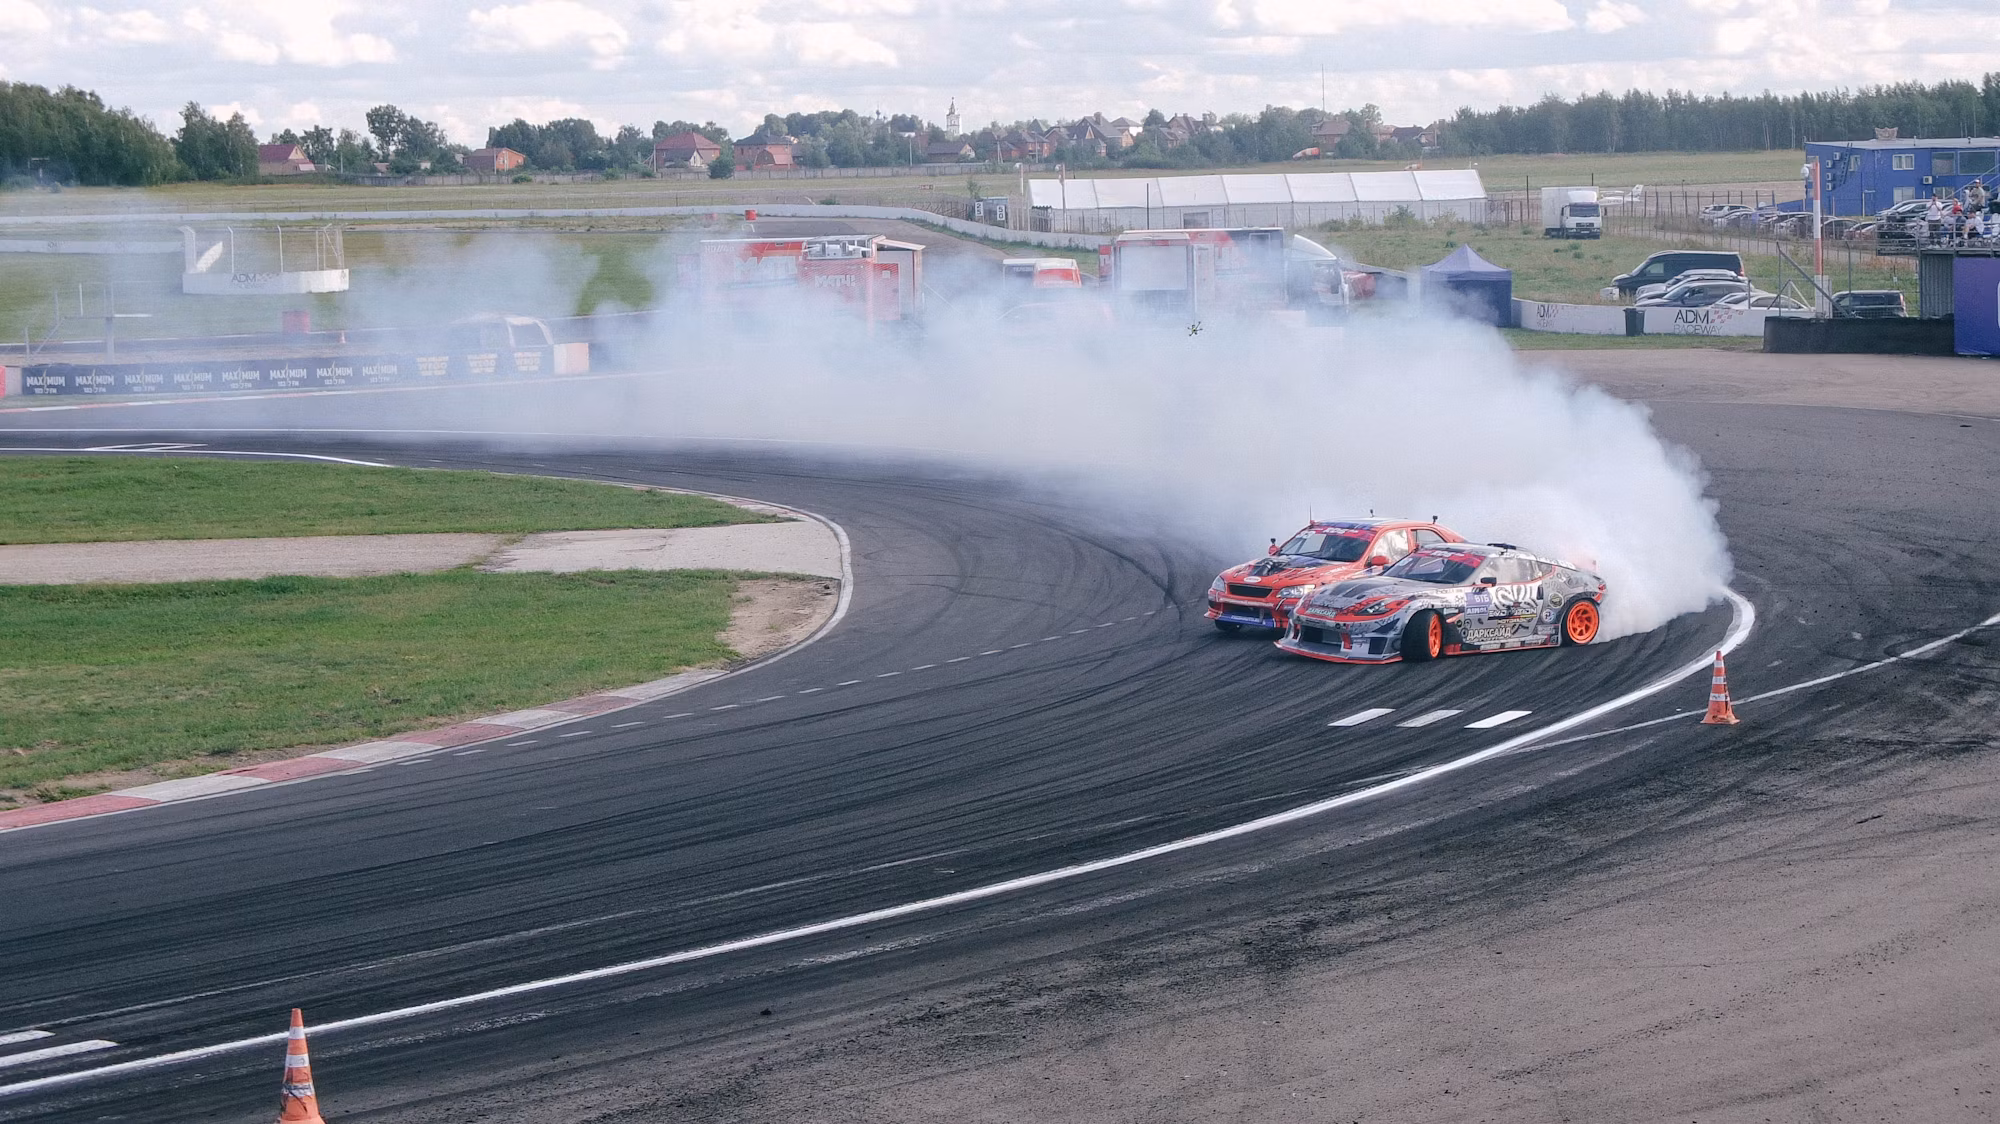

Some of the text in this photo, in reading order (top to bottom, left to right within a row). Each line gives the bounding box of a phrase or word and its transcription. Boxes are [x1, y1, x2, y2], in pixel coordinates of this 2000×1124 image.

[231, 274, 256, 283] ADM
[1674, 309, 1709, 324] ADM
[1673, 325, 1723, 335] RACEWAY
[26, 374, 66, 388] MAXIMUM
[75, 373, 115, 387] MAXIMUM
[1474, 594, 1489, 603] ВТБ
[1466, 626, 1511, 641] ДАРКСАЙД
